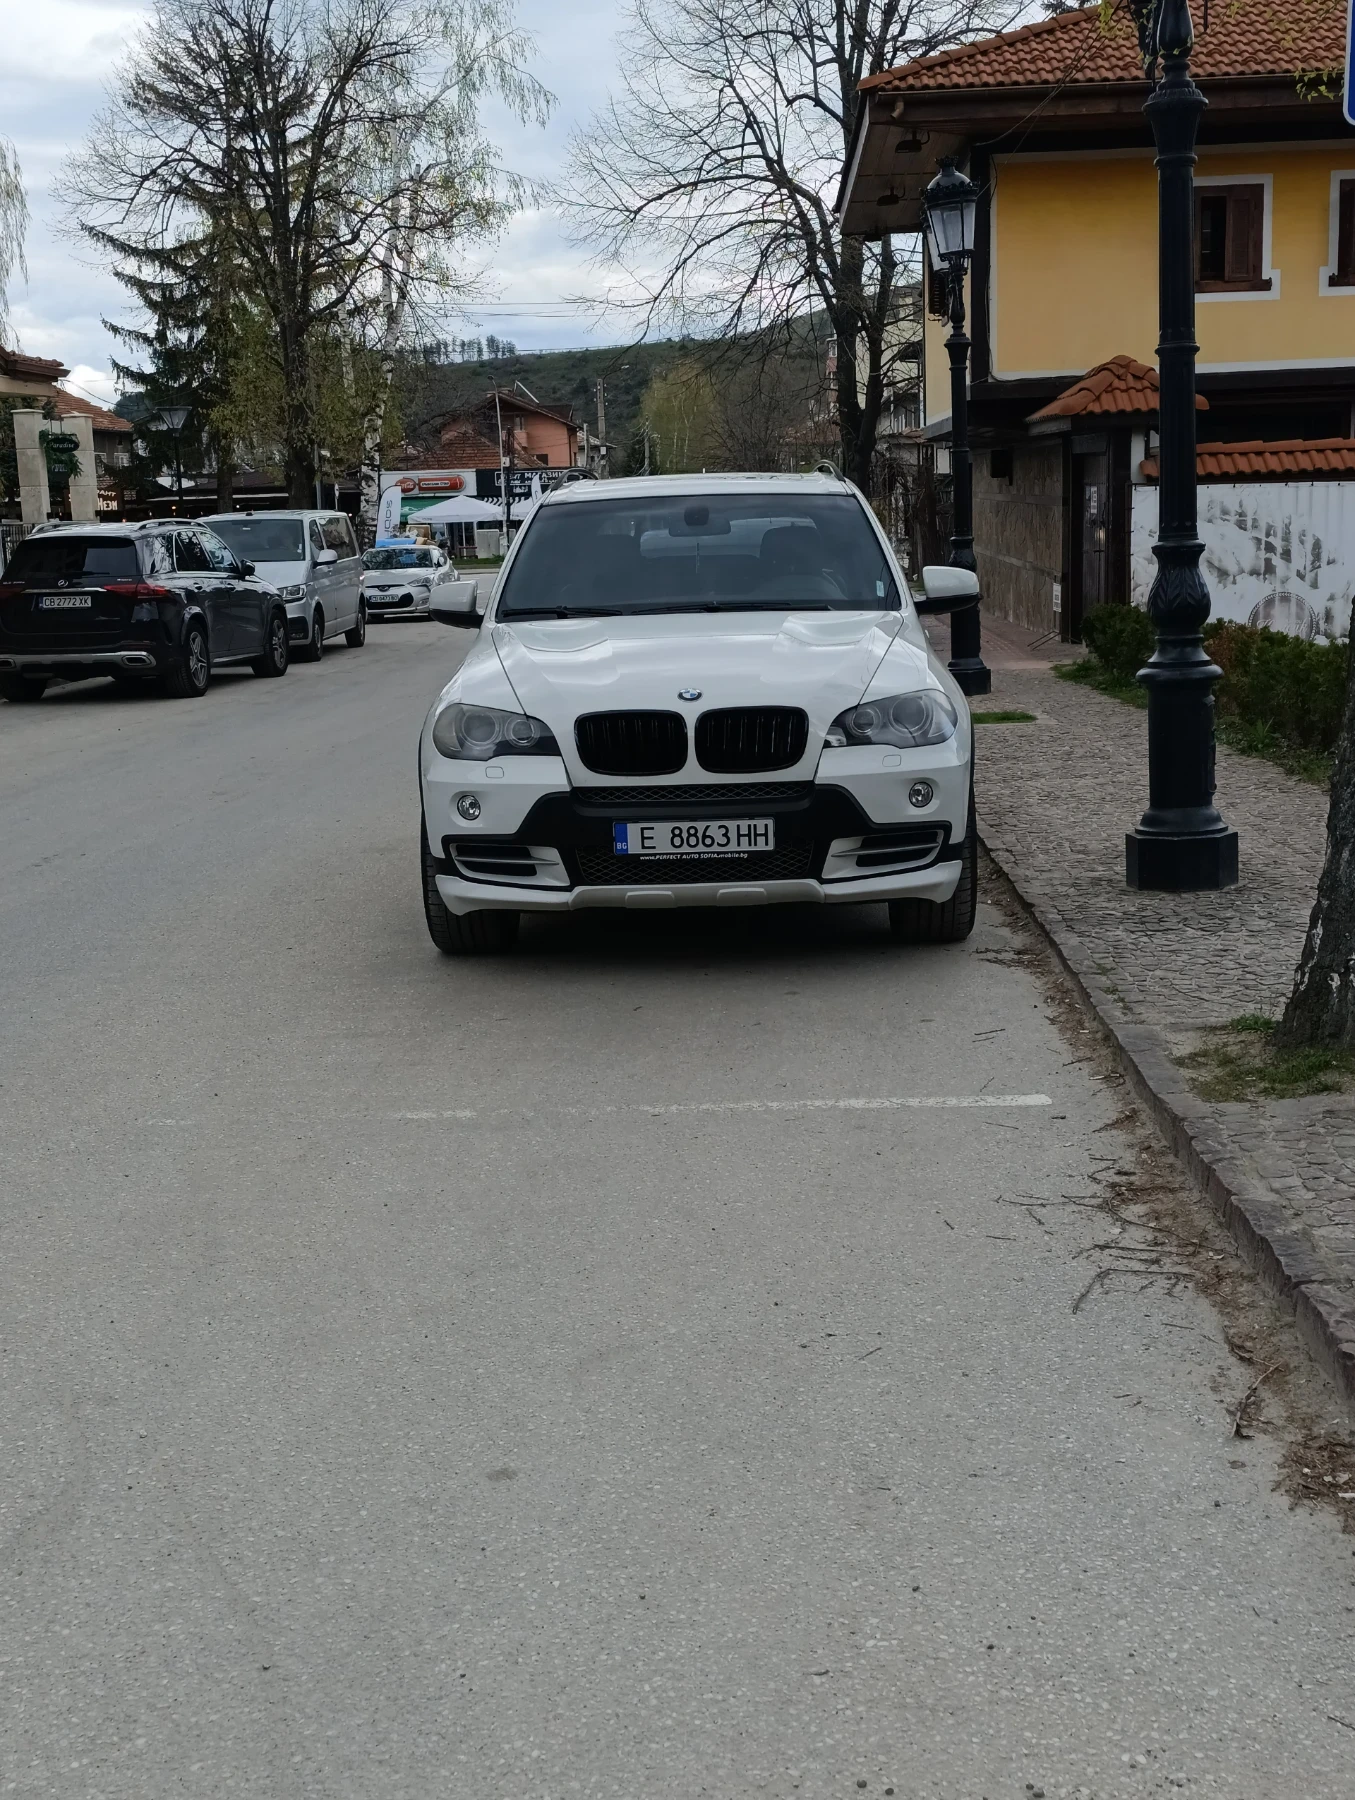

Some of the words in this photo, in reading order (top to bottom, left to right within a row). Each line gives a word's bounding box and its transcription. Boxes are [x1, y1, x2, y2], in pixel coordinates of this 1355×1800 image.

[56, 597, 77, 606] 2772
[79, 597, 89, 606] XK
[640, 827, 656, 849] E
[670, 824, 731, 849] 8863
[736, 823, 769, 847] HH
